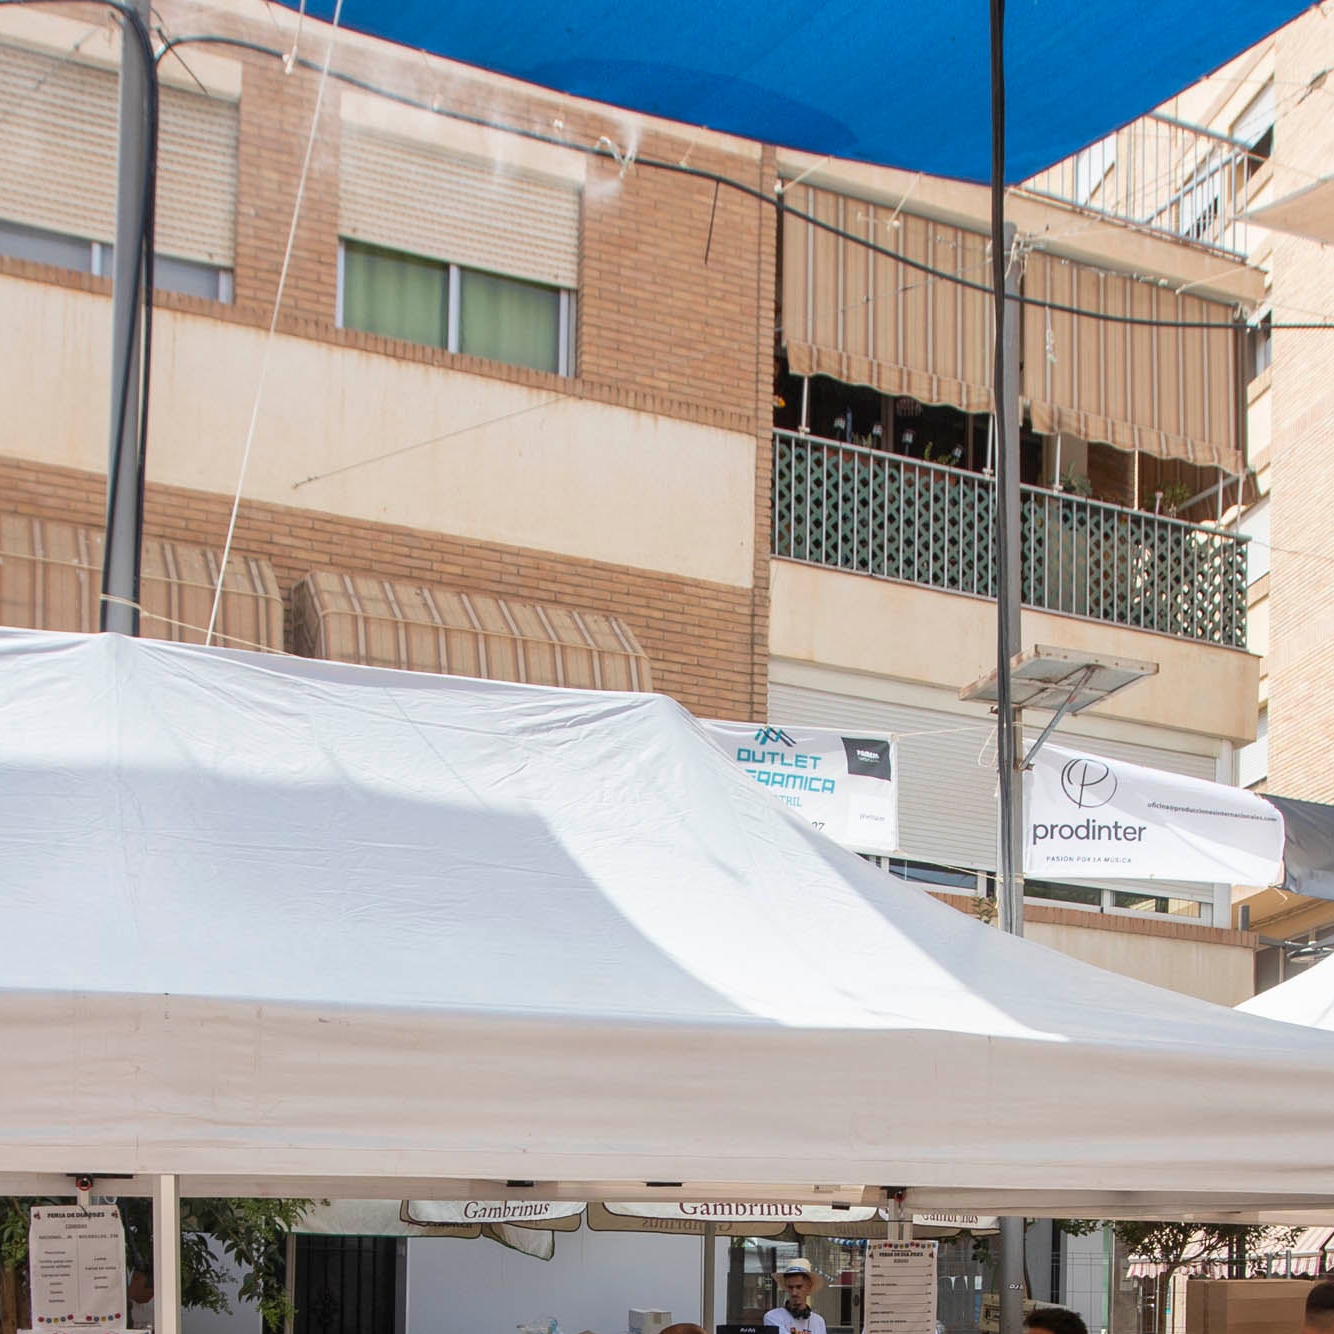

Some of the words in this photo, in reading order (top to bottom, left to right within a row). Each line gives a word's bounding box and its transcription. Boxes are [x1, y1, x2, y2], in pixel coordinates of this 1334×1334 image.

[736, 747, 823, 770] OUTLET
[1032, 818, 1147, 845] prodinter
[463, 1201, 551, 1219] Gambrinus
